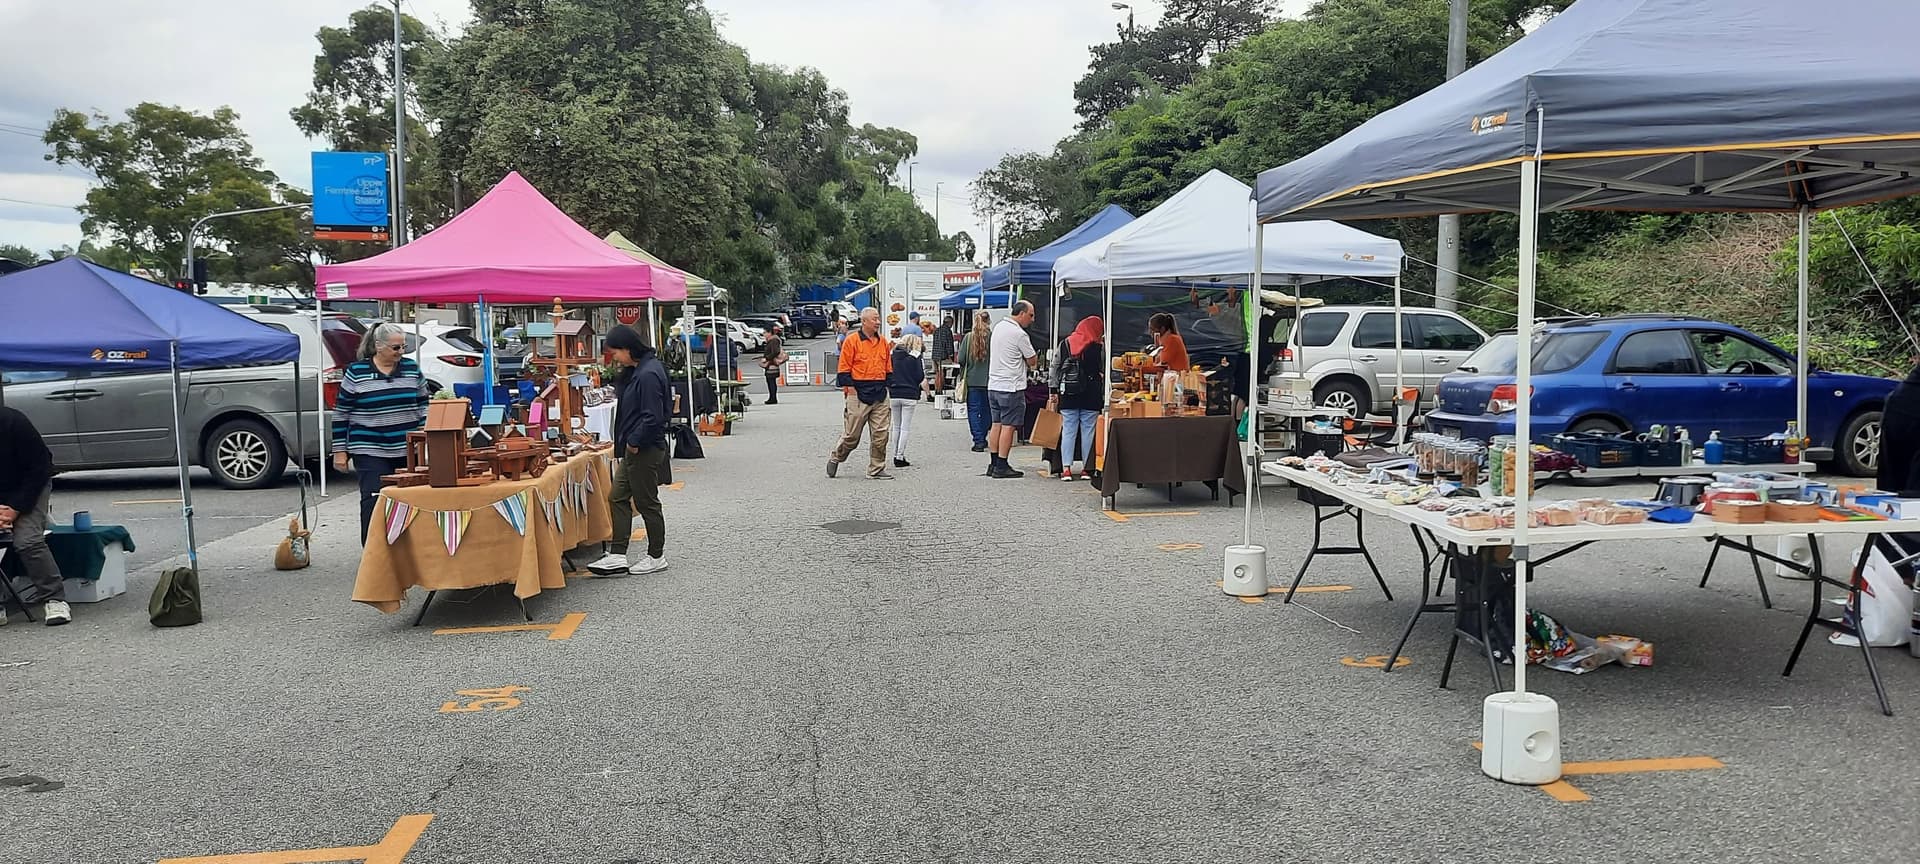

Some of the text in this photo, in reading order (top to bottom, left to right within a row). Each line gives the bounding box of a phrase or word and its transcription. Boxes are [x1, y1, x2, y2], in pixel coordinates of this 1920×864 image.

[357, 178, 384, 187] Upper
[354, 195, 385, 205] Station
[617, 307, 639, 318] STOP
[107, 350, 147, 359] OZtrail
[438, 684, 532, 714] 54
